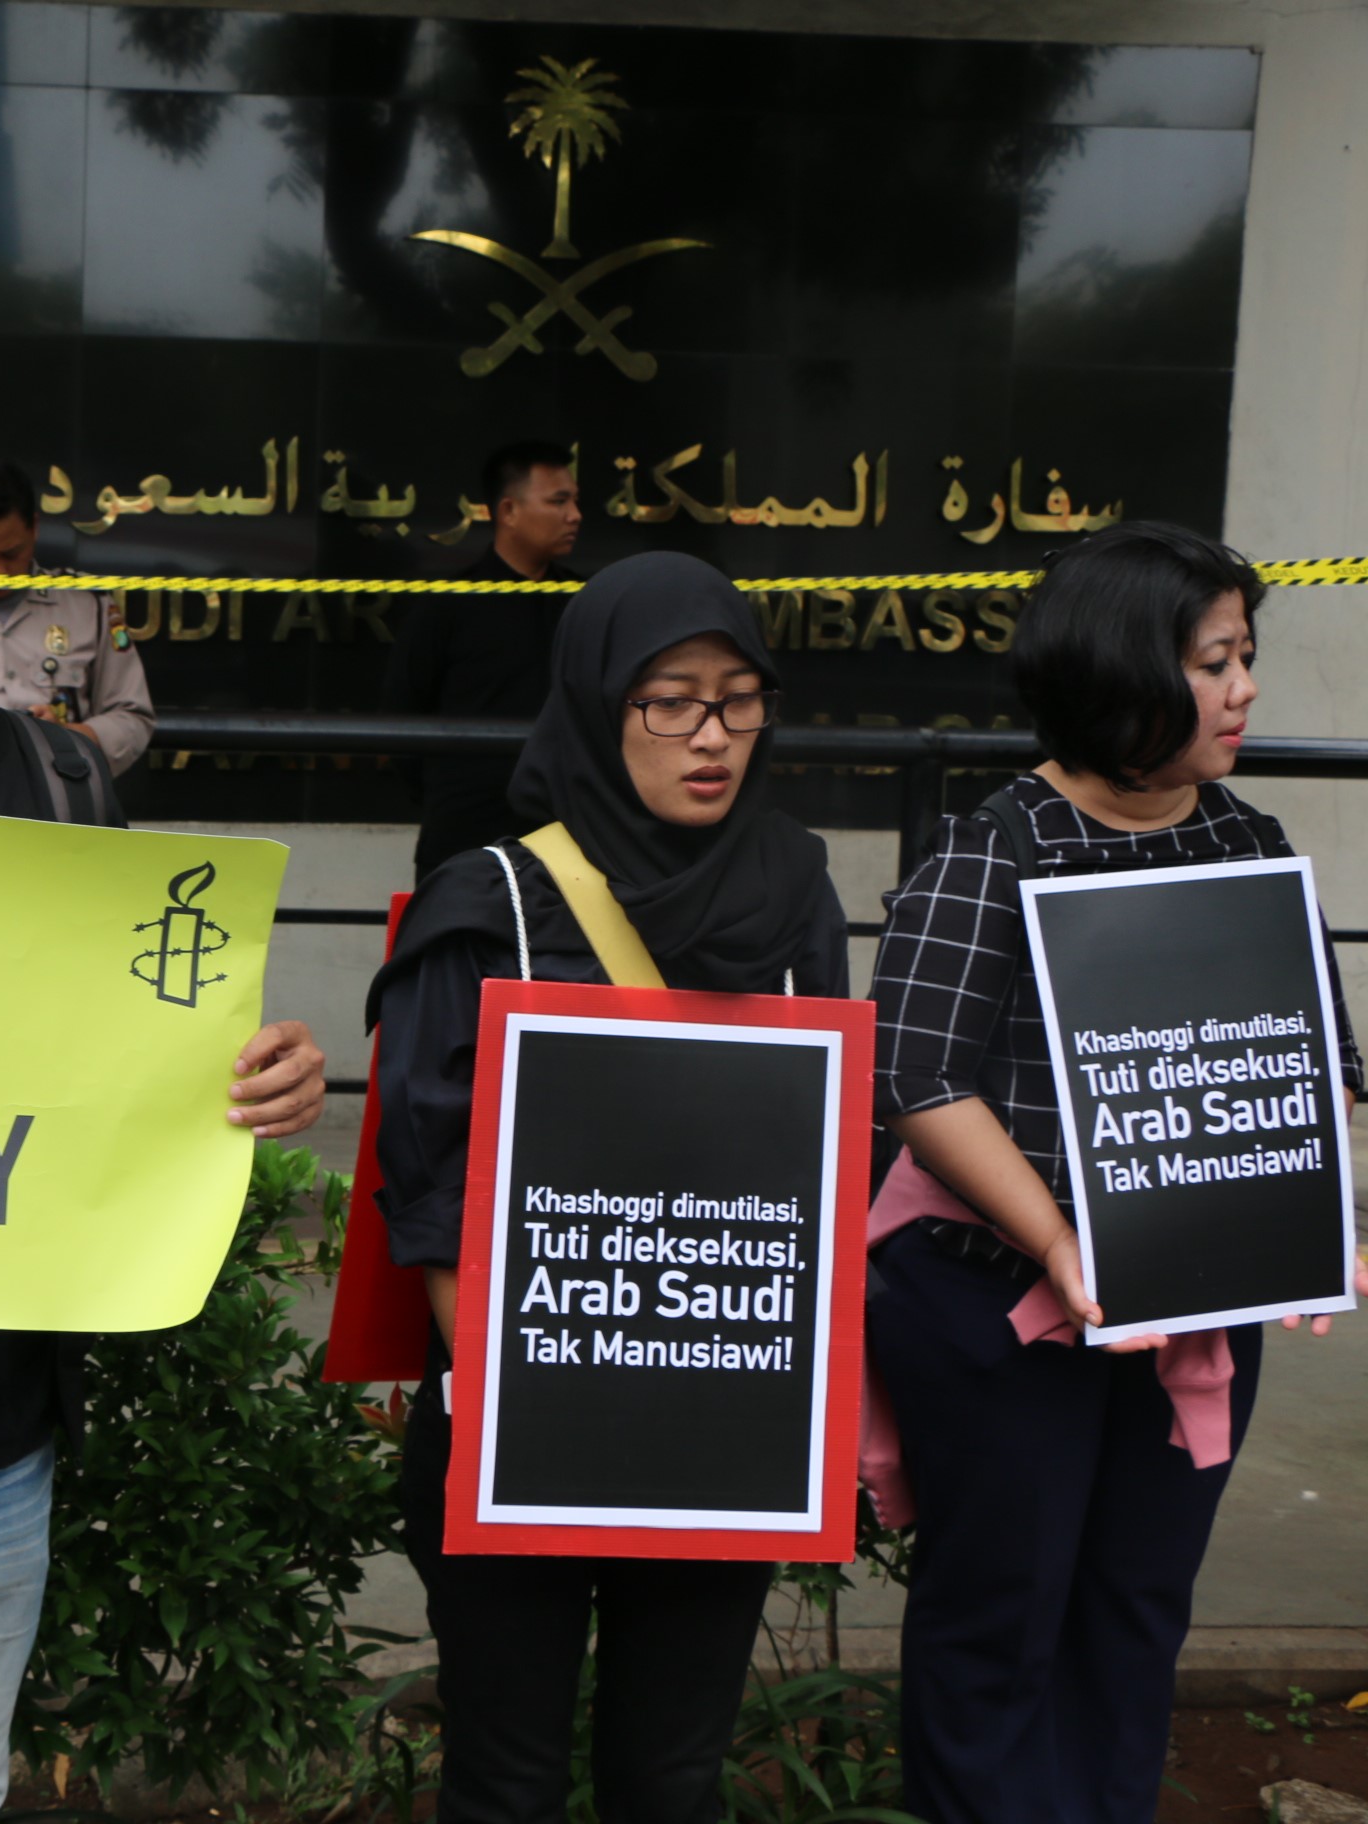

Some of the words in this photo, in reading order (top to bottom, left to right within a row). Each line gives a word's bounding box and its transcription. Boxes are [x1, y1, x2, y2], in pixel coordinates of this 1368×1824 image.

[606, 443, 888, 528] المملكة
[941, 455, 1123, 545] سفارة
[1074, 1021, 1194, 1055] Khashoggi
[1080, 1060, 1140, 1097] Tuti
[1092, 1095, 1192, 1148] Arab
[1202, 1081, 1318, 1135] Saudi
[1096, 1158, 1153, 1193] Tak
[1158, 1138, 1323, 1186] Manusiawi!
[525, 1186, 664, 1223] Khashoggi
[671, 1193, 804, 1225] dimutilasi,
[524, 1222, 589, 1260] Tuti
[601, 1225, 806, 1271] dieksekusi,
[520, 1265, 641, 1316] Arab
[655, 1270, 795, 1322] Saudi
[520, 1328, 582, 1364] Tak
[592, 1330, 793, 1371] Manusiawi!
